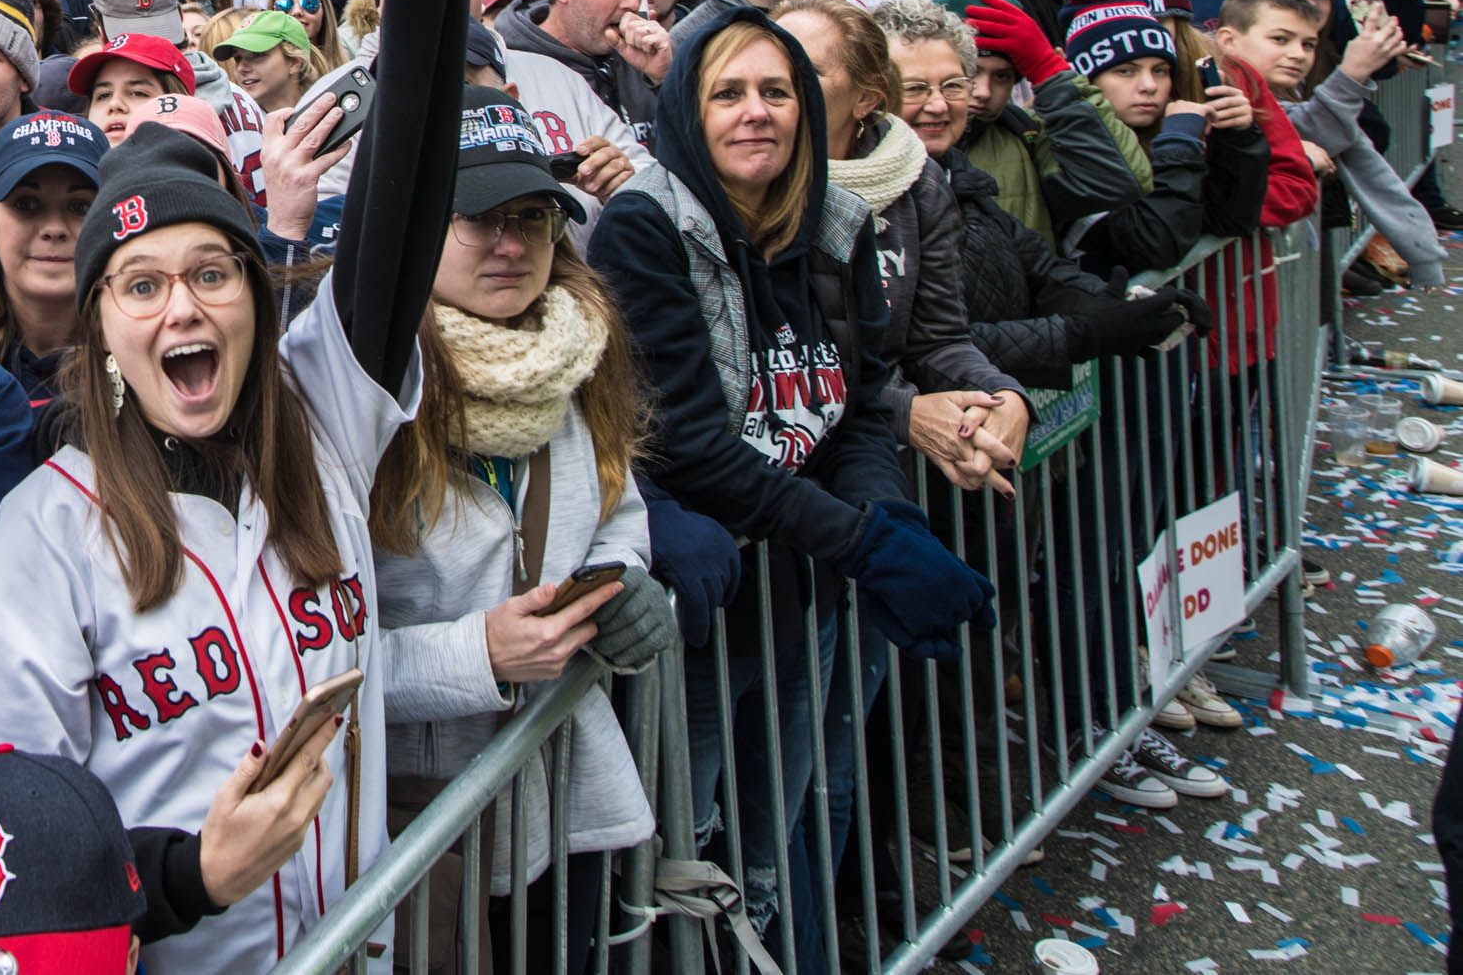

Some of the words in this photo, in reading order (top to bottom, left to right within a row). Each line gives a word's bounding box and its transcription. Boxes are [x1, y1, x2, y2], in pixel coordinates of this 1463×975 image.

[155, 96, 178, 115] B
[497, 107, 514, 124] B
[12, 119, 93, 142] CHAMPIONS
[532, 111, 574, 155] B
[112, 194, 149, 240] B
[1189, 521, 1236, 567] DONE
[1182, 587, 1210, 621] DD
[95, 625, 242, 742] RED
